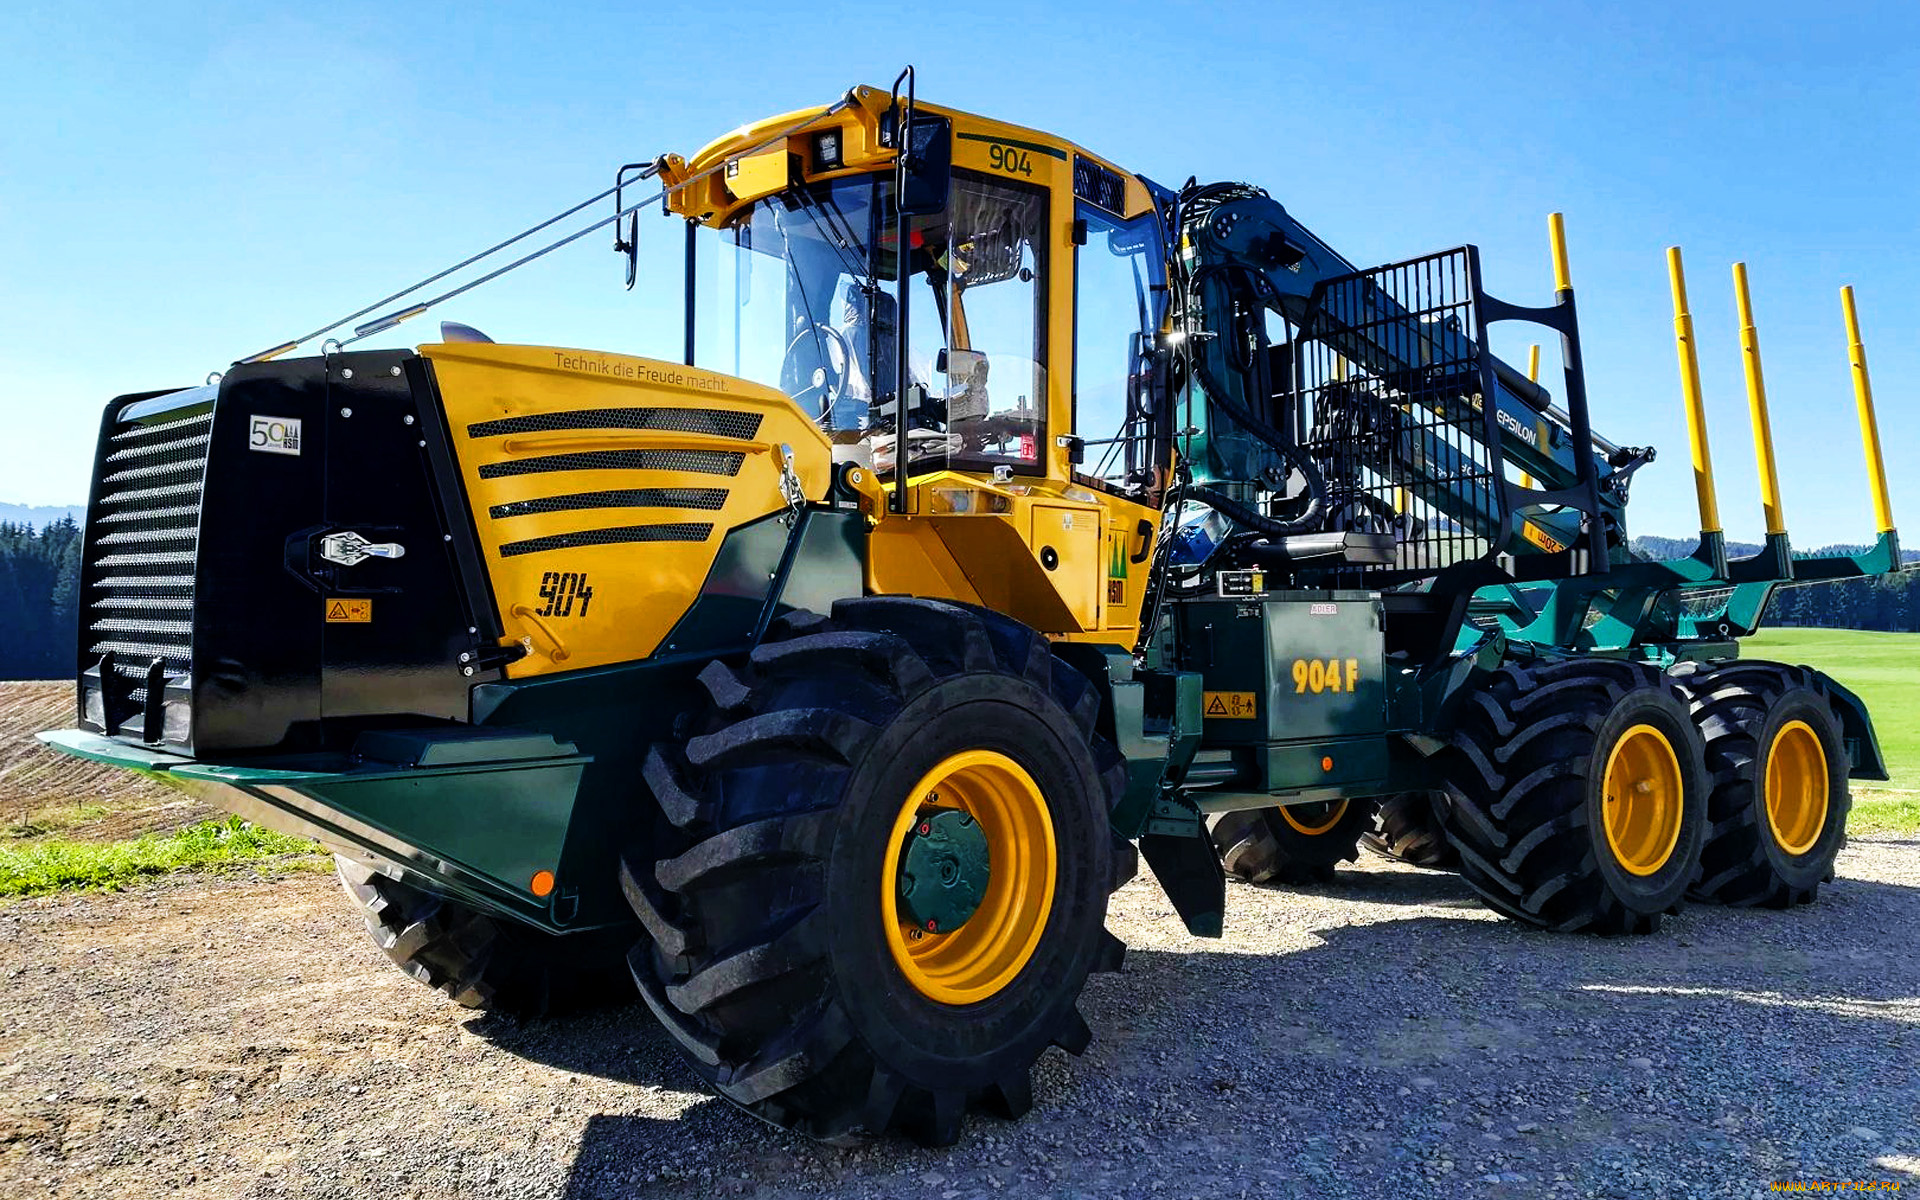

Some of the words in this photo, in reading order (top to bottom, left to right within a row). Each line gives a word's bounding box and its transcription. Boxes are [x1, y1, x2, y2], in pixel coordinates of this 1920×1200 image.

[989, 144, 1032, 177] 904
[554, 352, 609, 375] Technik
[613, 362, 634, 378] die
[637, 365, 683, 385] Freude
[686, 375, 729, 392] macht.
[1496, 409, 1537, 446] EPSILON
[535, 572, 593, 617] 904
[1292, 659, 1341, 693] 904
[1345, 659, 1358, 693] F
